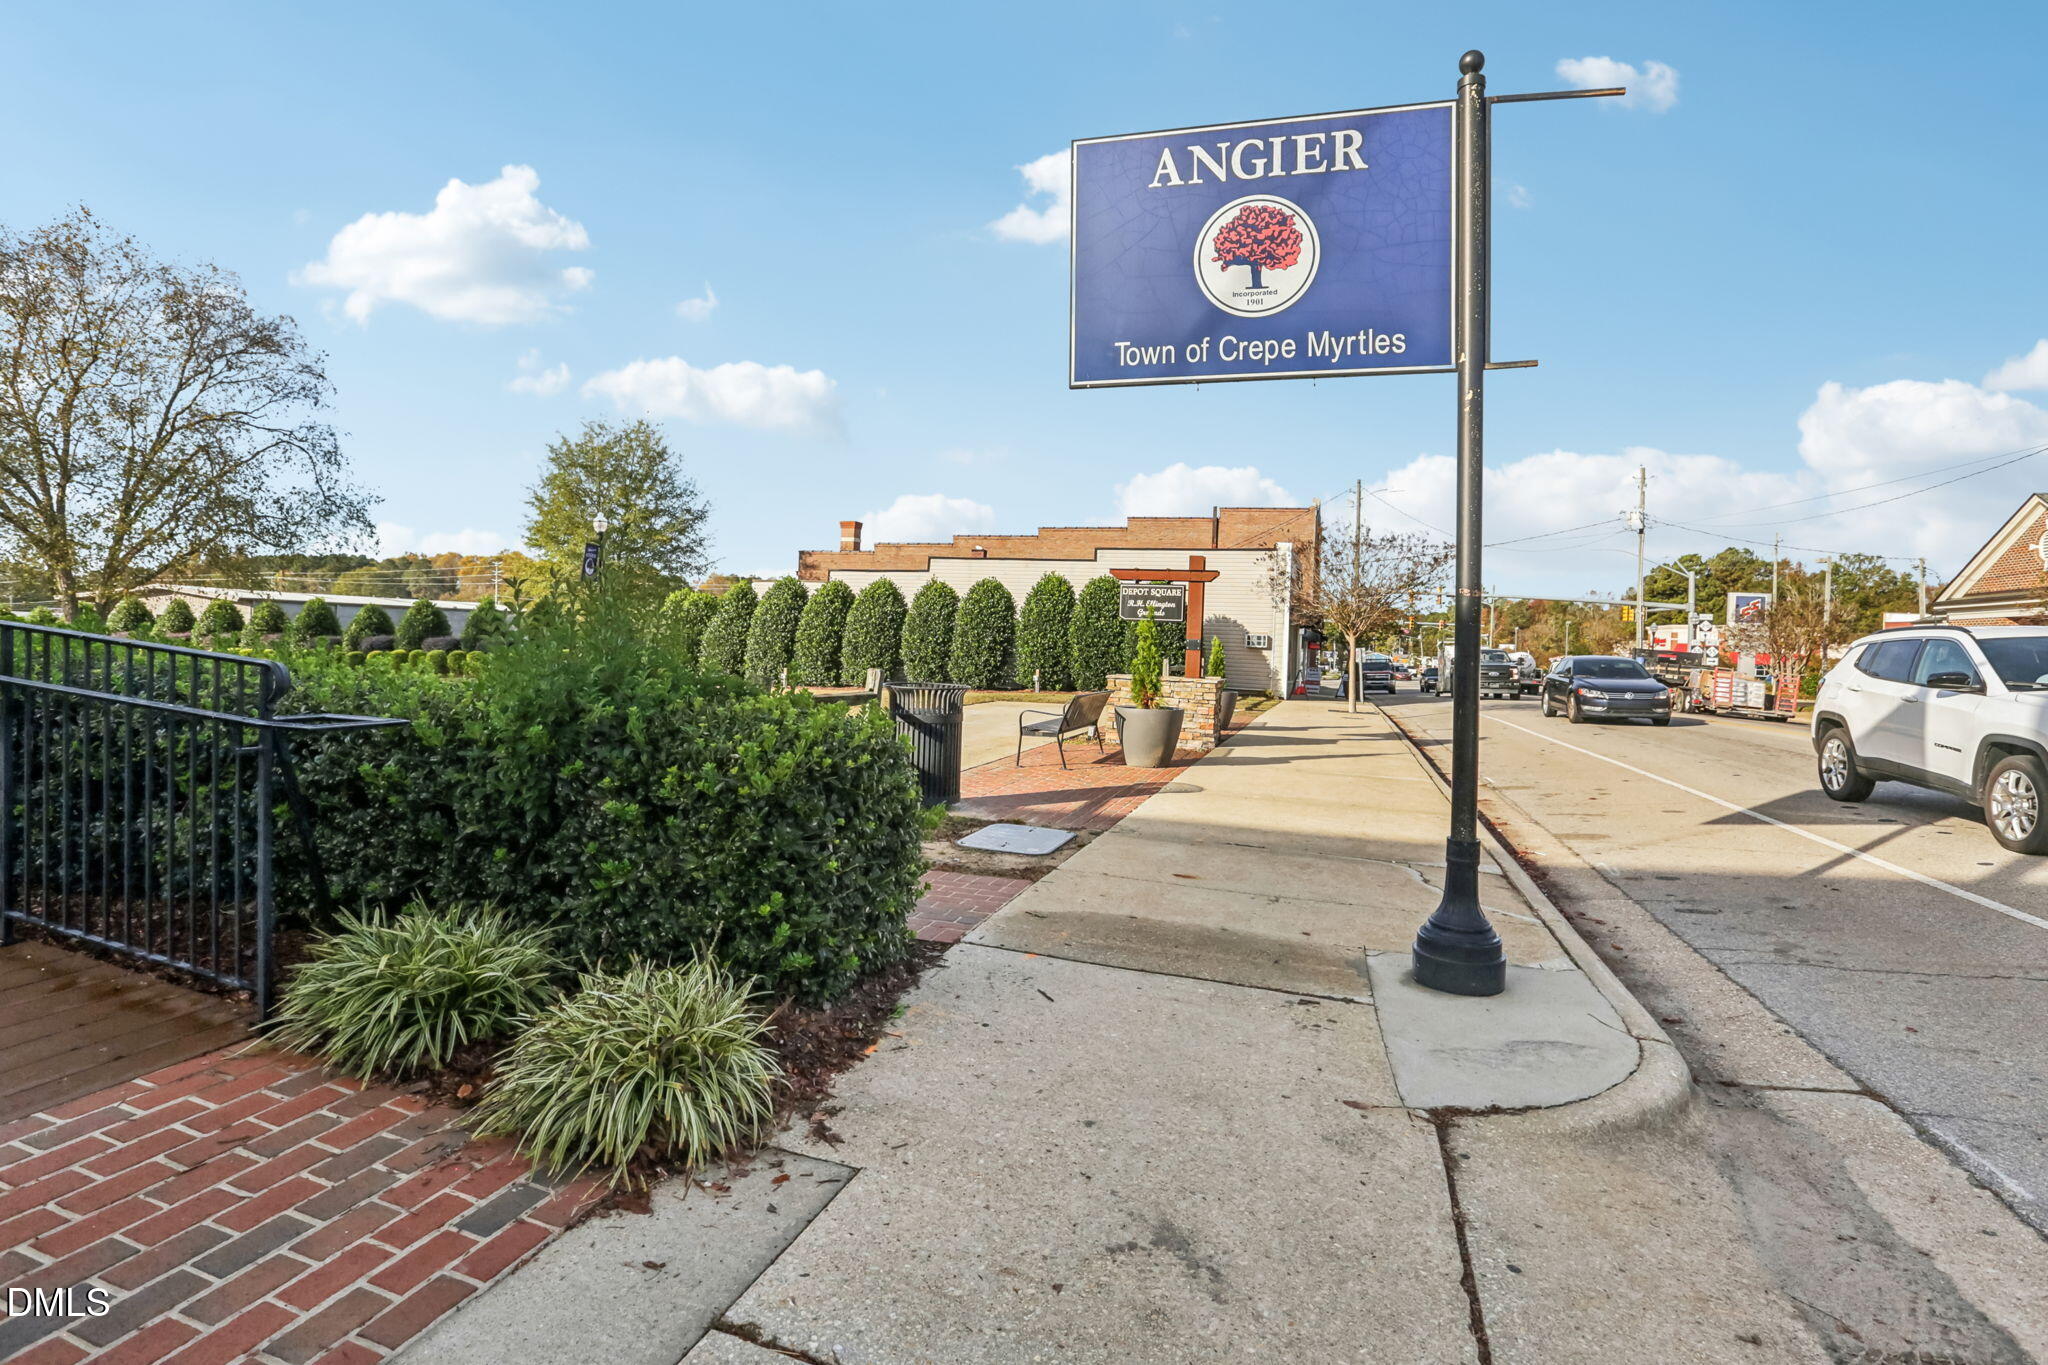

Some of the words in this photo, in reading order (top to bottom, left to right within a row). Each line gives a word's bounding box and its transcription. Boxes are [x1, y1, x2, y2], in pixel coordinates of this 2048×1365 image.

[1148, 129, 1368, 188] ANGIER
[1232, 289, 1278, 298] Incorporated
[1114, 341, 1175, 366] Town
[1186, 337, 1210, 363] of
[1218, 335, 1296, 366] Crepe
[1307, 329, 1406, 364] Myrtles
[1122, 587, 1149, 596] DEPOT
[1150, 588, 1182, 597] SQUARE
[1137, 608, 1165, 617] Grnds
